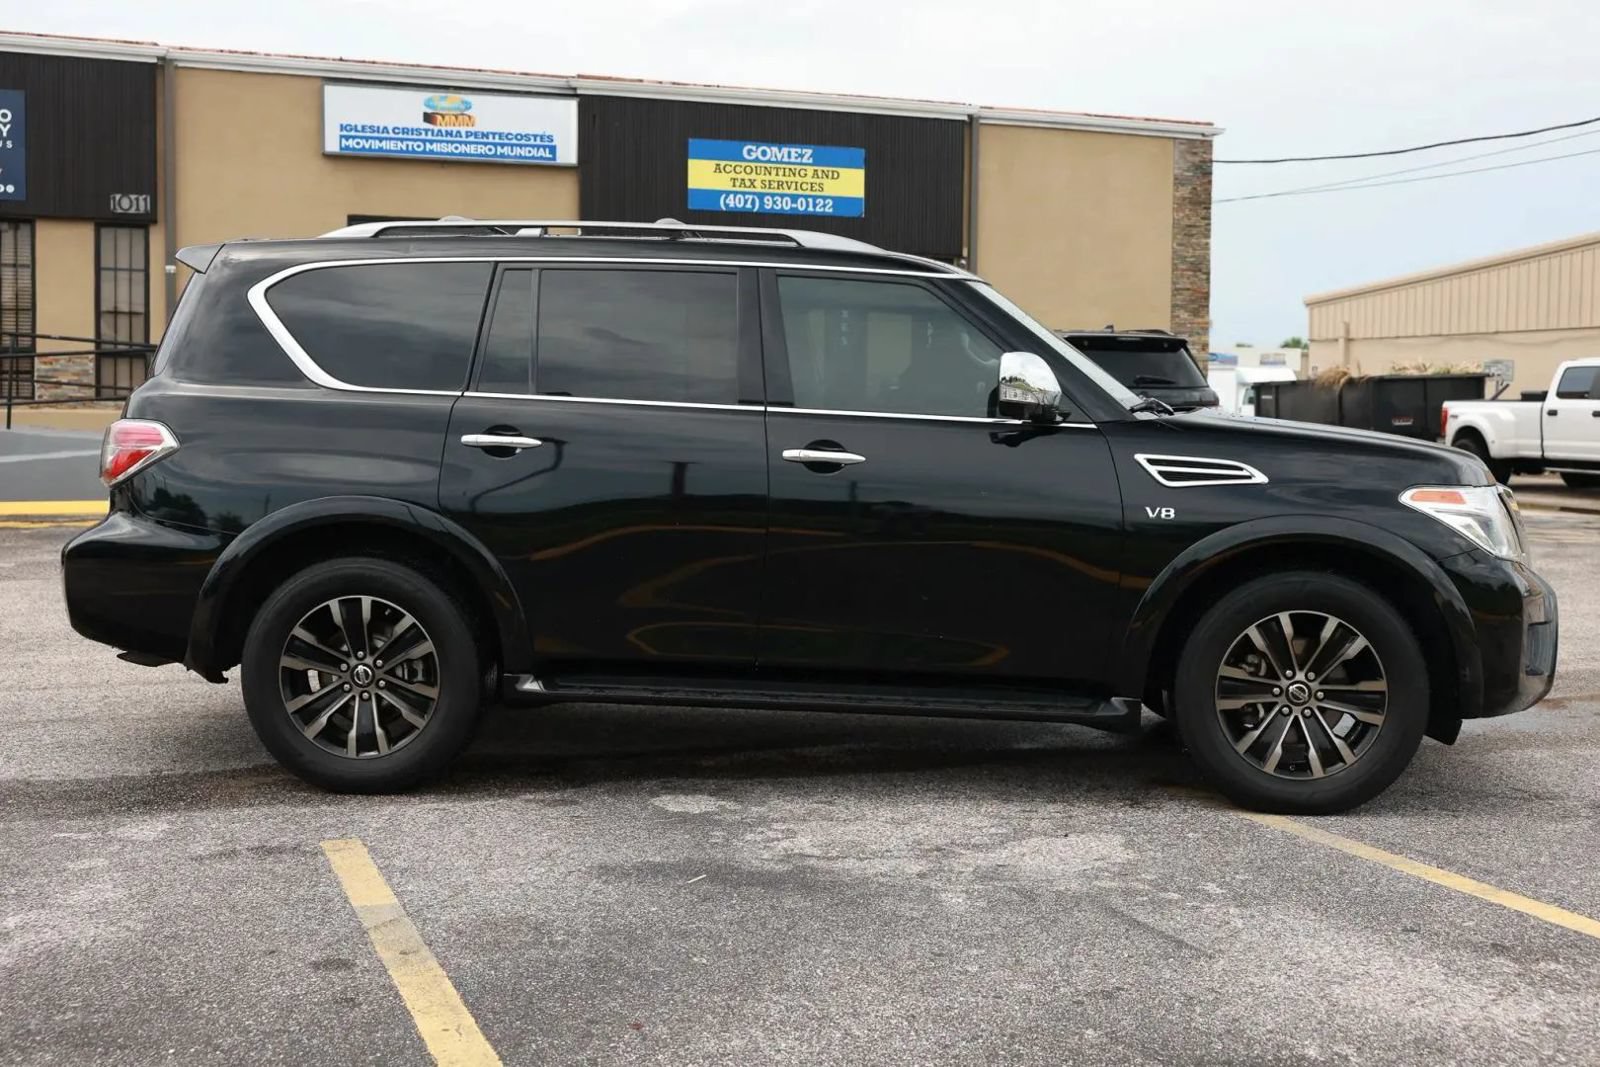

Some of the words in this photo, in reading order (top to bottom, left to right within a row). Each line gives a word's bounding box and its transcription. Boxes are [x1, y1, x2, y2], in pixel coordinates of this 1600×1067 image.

[339, 123, 390, 135] IGLESIA
[392, 126, 463, 139] CRISTIANA
[465, 129, 554, 143] PENTECOSTÉS
[341, 138, 424, 151] MOVIMIENTO
[426, 141, 496, 155] MISIONERO
[497, 145, 553, 158] MUNDIAL
[742, 145, 813, 163] GOMEZ
[713, 163, 808, 179] ACCOUNTING
[811, 169, 840, 180] AND
[730, 177, 756, 189] TAX
[760, 179, 824, 192] SERVICES
[719, 193, 760, 212] (407)
[764, 195, 833, 213] 930-0122
[1144, 506, 1176, 520] V8
